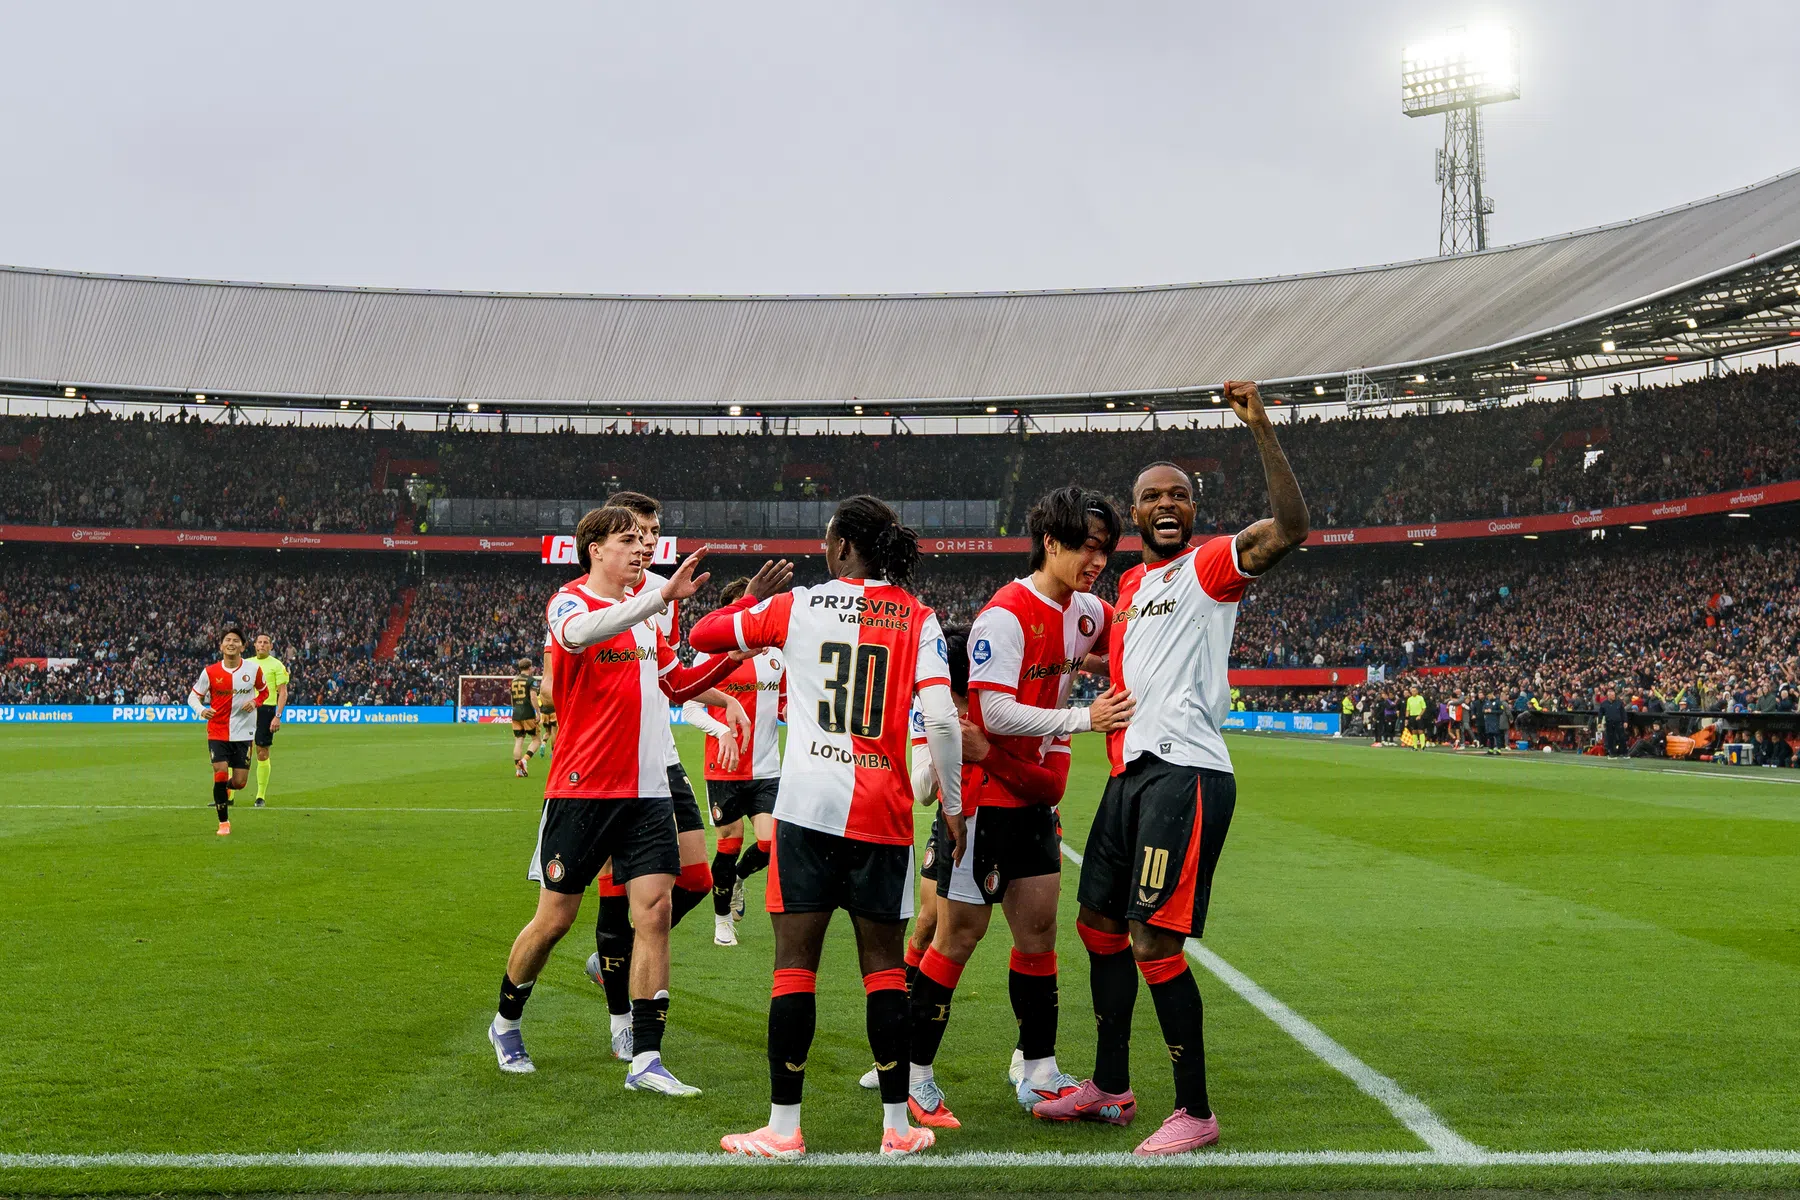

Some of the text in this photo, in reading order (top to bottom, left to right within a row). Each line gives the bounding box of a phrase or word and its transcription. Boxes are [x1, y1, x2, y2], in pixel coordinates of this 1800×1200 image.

[1572, 514, 1604, 525] Quooker
[1406, 525, 1437, 538] univé
[1488, 521, 1522, 532] Quooker
[1323, 530, 1354, 542] univé
[935, 540, 985, 550] ORMER
[838, 613, 908, 632] vakanties
[593, 648, 635, 665] Media
[511, 680, 527, 699] 55
[724, 683, 755, 693] Media
[816, 640, 890, 740] 30
[18, 710, 73, 721] vakanties
[364, 711, 419, 723] vakanties
[810, 740, 892, 771] LOTOMBA
[1140, 846, 1169, 889] 10
